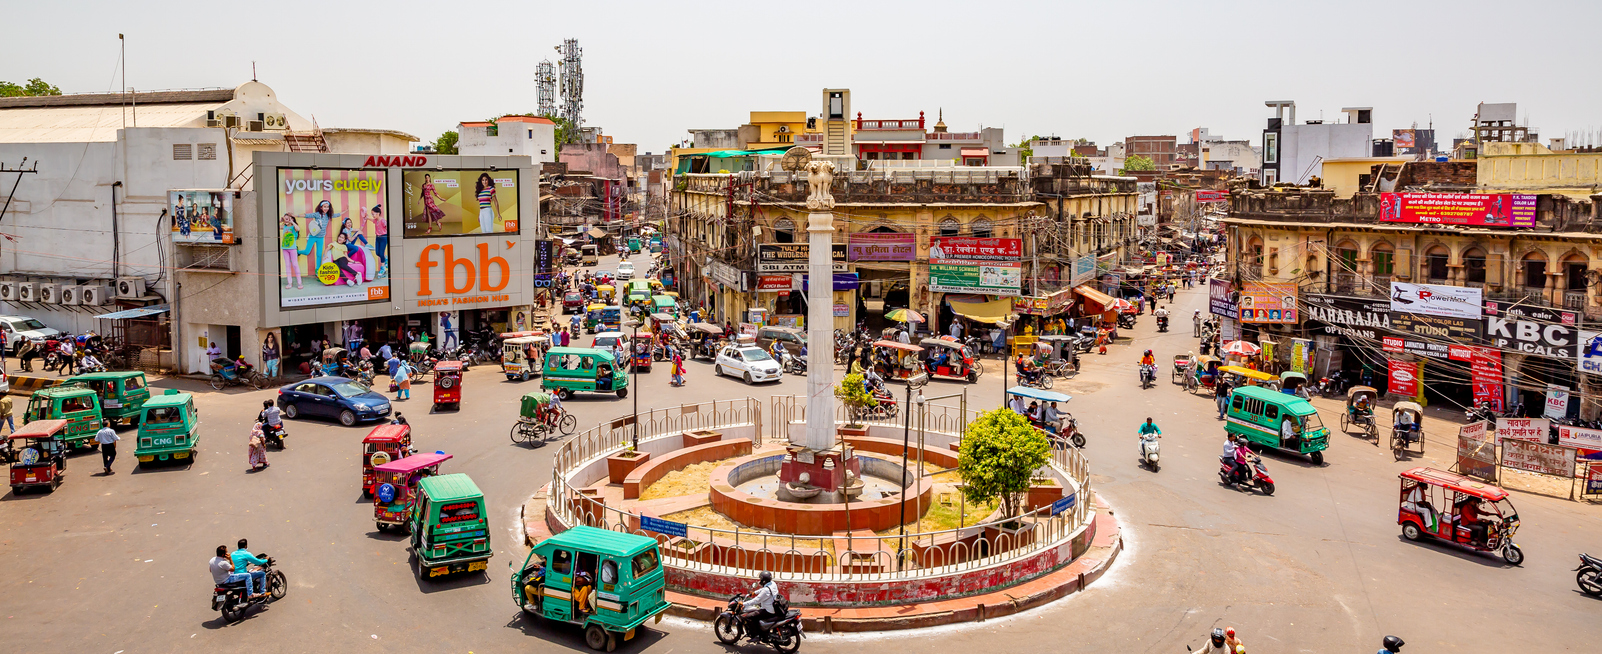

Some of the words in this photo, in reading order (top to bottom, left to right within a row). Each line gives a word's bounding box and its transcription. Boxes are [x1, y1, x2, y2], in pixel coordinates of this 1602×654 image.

[364, 156, 428, 168] ANAND
[286, 179, 332, 194] yours
[334, 177, 382, 194] cutely
[853, 246, 863, 255] न्यू
[893, 245, 912, 253] होटल
[416, 242, 510, 296] fbb
[418, 299, 449, 307] INDIA'S
[452, 296, 489, 304] FASHION
[1212, 300, 1228, 309] CONTACT
[1325, 326, 1375, 339] OPTICIANS
[1414, 325, 1449, 336] STUDIO
[1488, 316, 1569, 346] KBC
[1383, 338, 1402, 347] STUDIO
[1547, 398, 1565, 407] KBC
[70, 424, 88, 433] CNG
[1463, 423, 1482, 434] सावधान
[1499, 427, 1510, 436] कार्य
[1512, 427, 1526, 437] प्रगति
[1521, 461, 1542, 471] निगम
